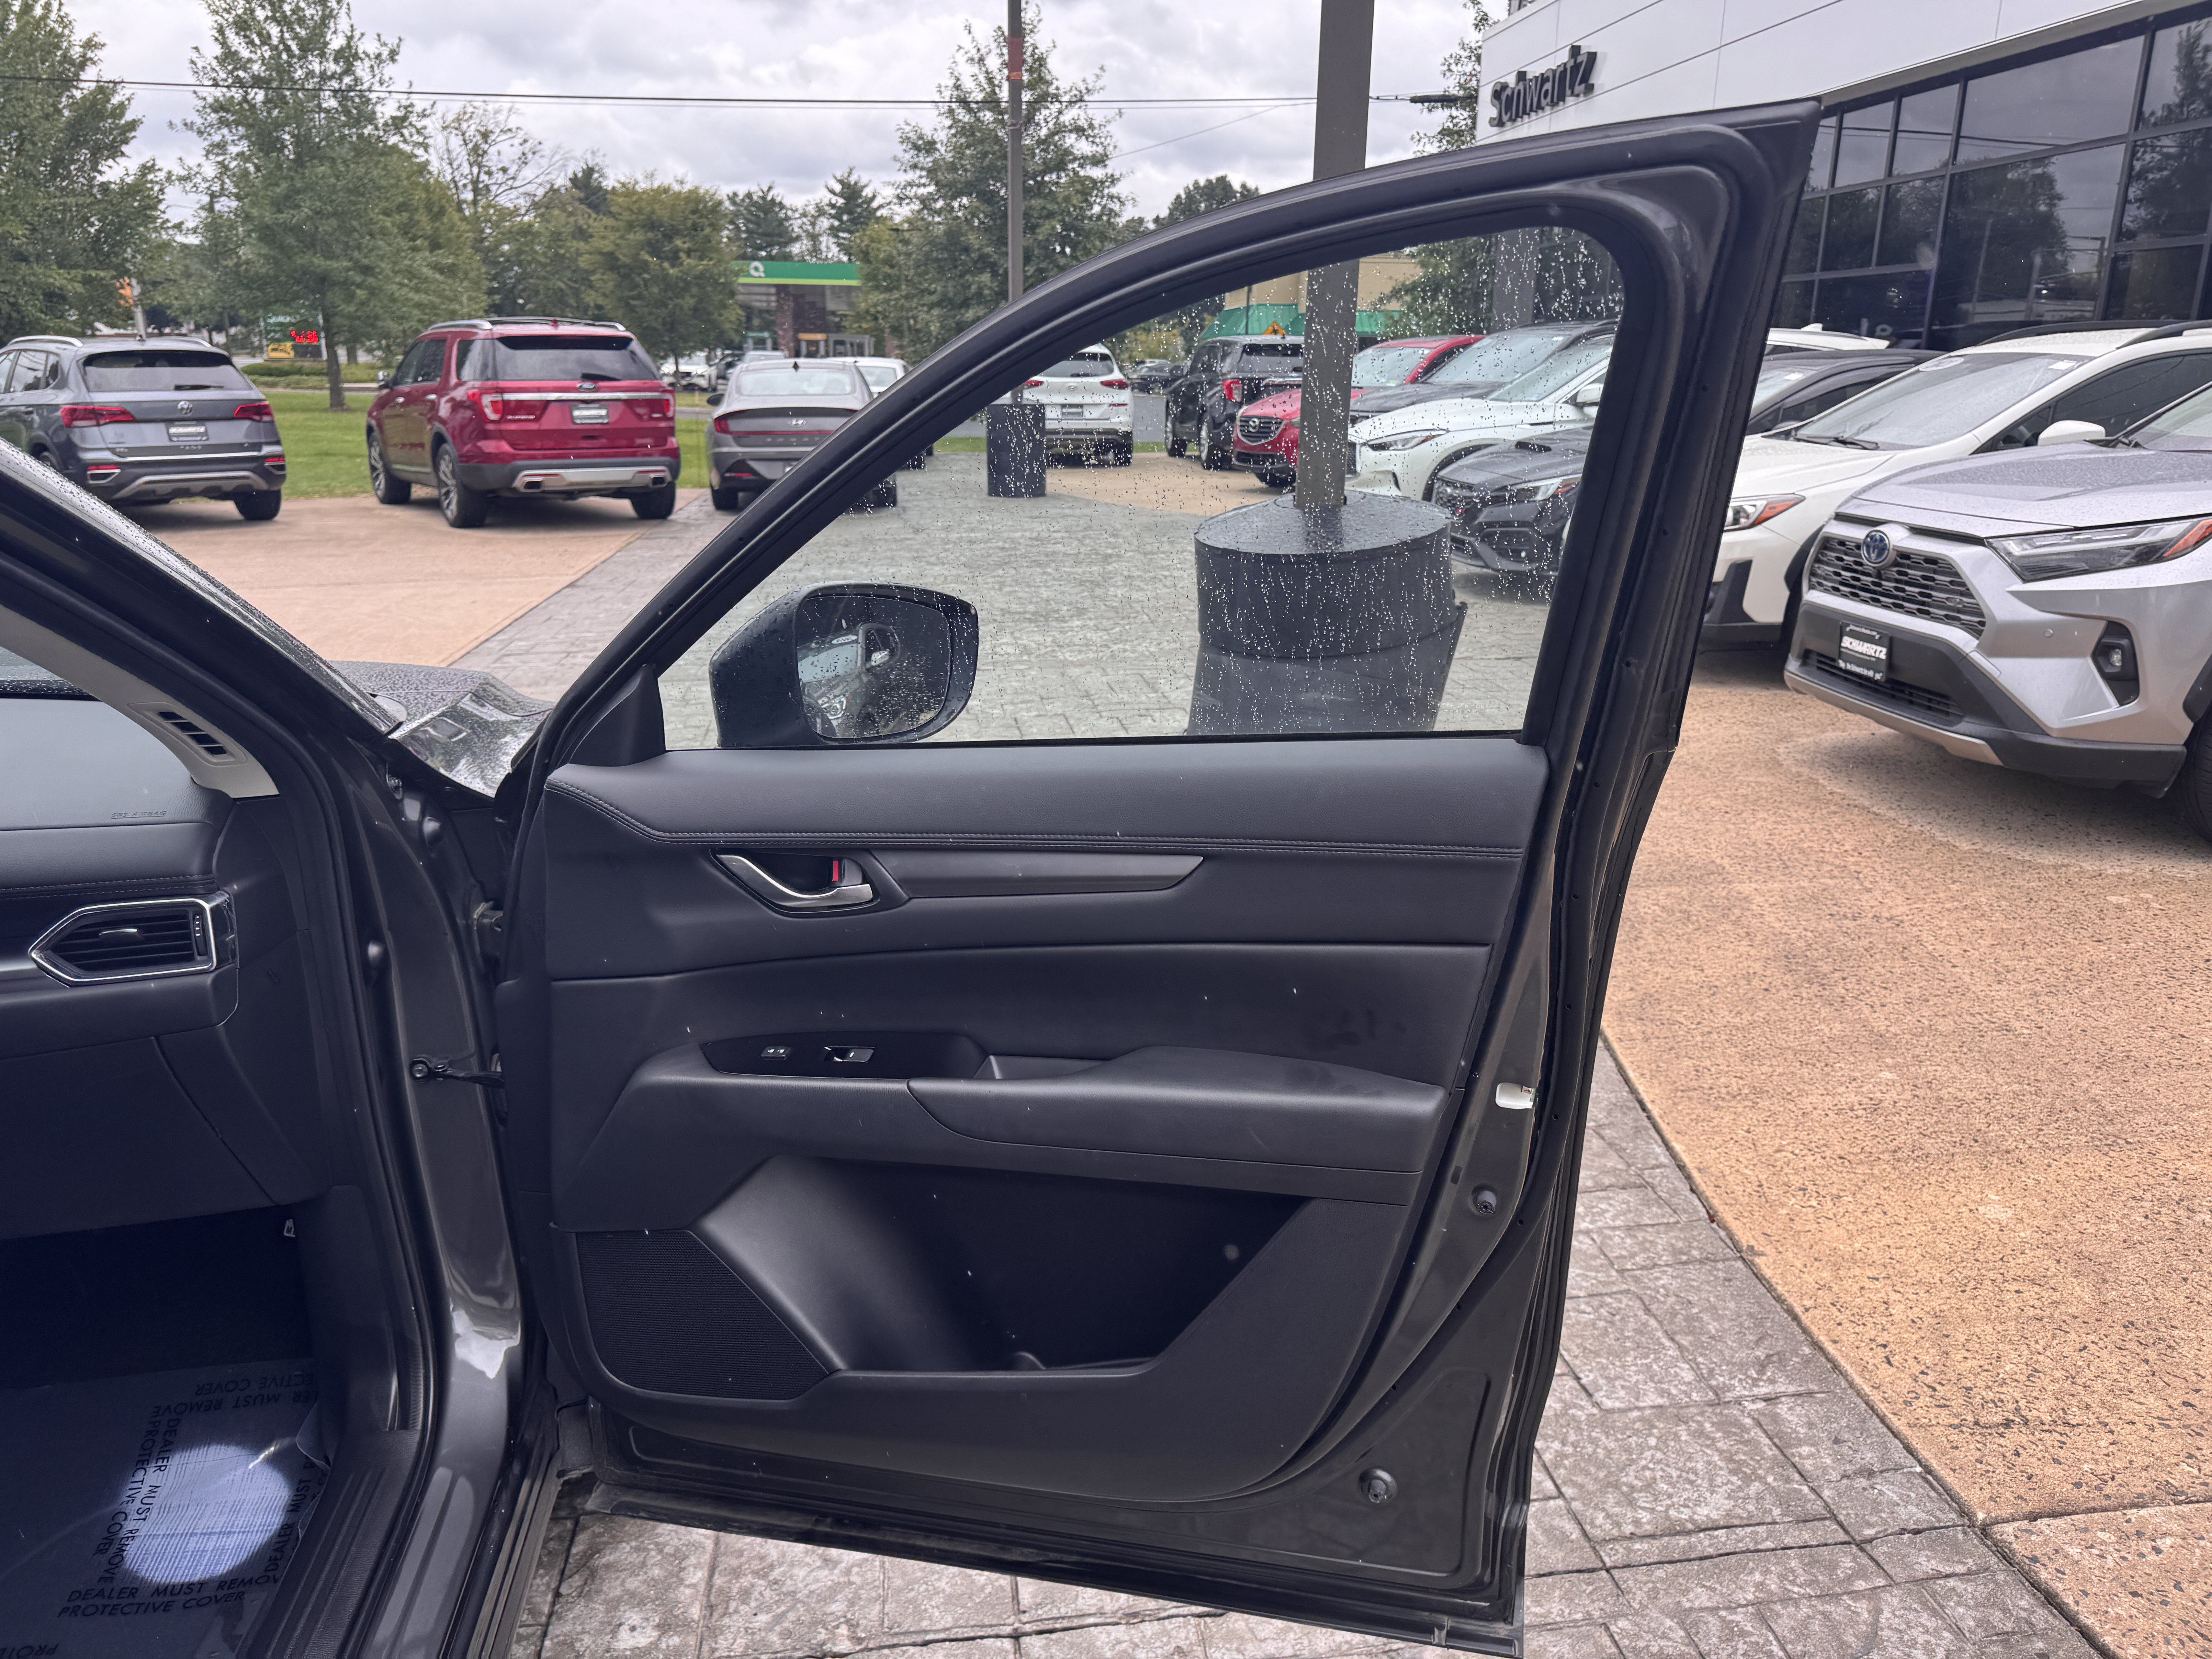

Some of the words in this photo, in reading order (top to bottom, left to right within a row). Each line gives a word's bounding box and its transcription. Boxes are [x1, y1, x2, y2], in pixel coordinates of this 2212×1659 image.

[1489, 45, 1597, 127] Schwartz
[1841, 635, 1887, 660] SCHWARTZ
[195, 1379, 251, 1396] COVER
[232, 1393, 281, 1408] MUST
[151, 1398, 223, 1418] REMOVE
[120, 1420, 161, 1506] PROTECTIVE
[153, 1418, 180, 1473] DEALER
[133, 1485, 162, 1522] MUST
[93, 1511, 127, 1556] COVER
[264, 1522, 295, 1572] DEALER
[287, 1479, 311, 1513] MUST
[98, 1529, 139, 1583] REMOVE
[57, 1600, 175, 1618] PROTECTIVE
[182, 1591, 246, 1609] COVER
[67, 1587, 139, 1603] DEALER
[151, 1582, 208, 1598] MUST
[216, 1575, 281, 1591] REMOV
